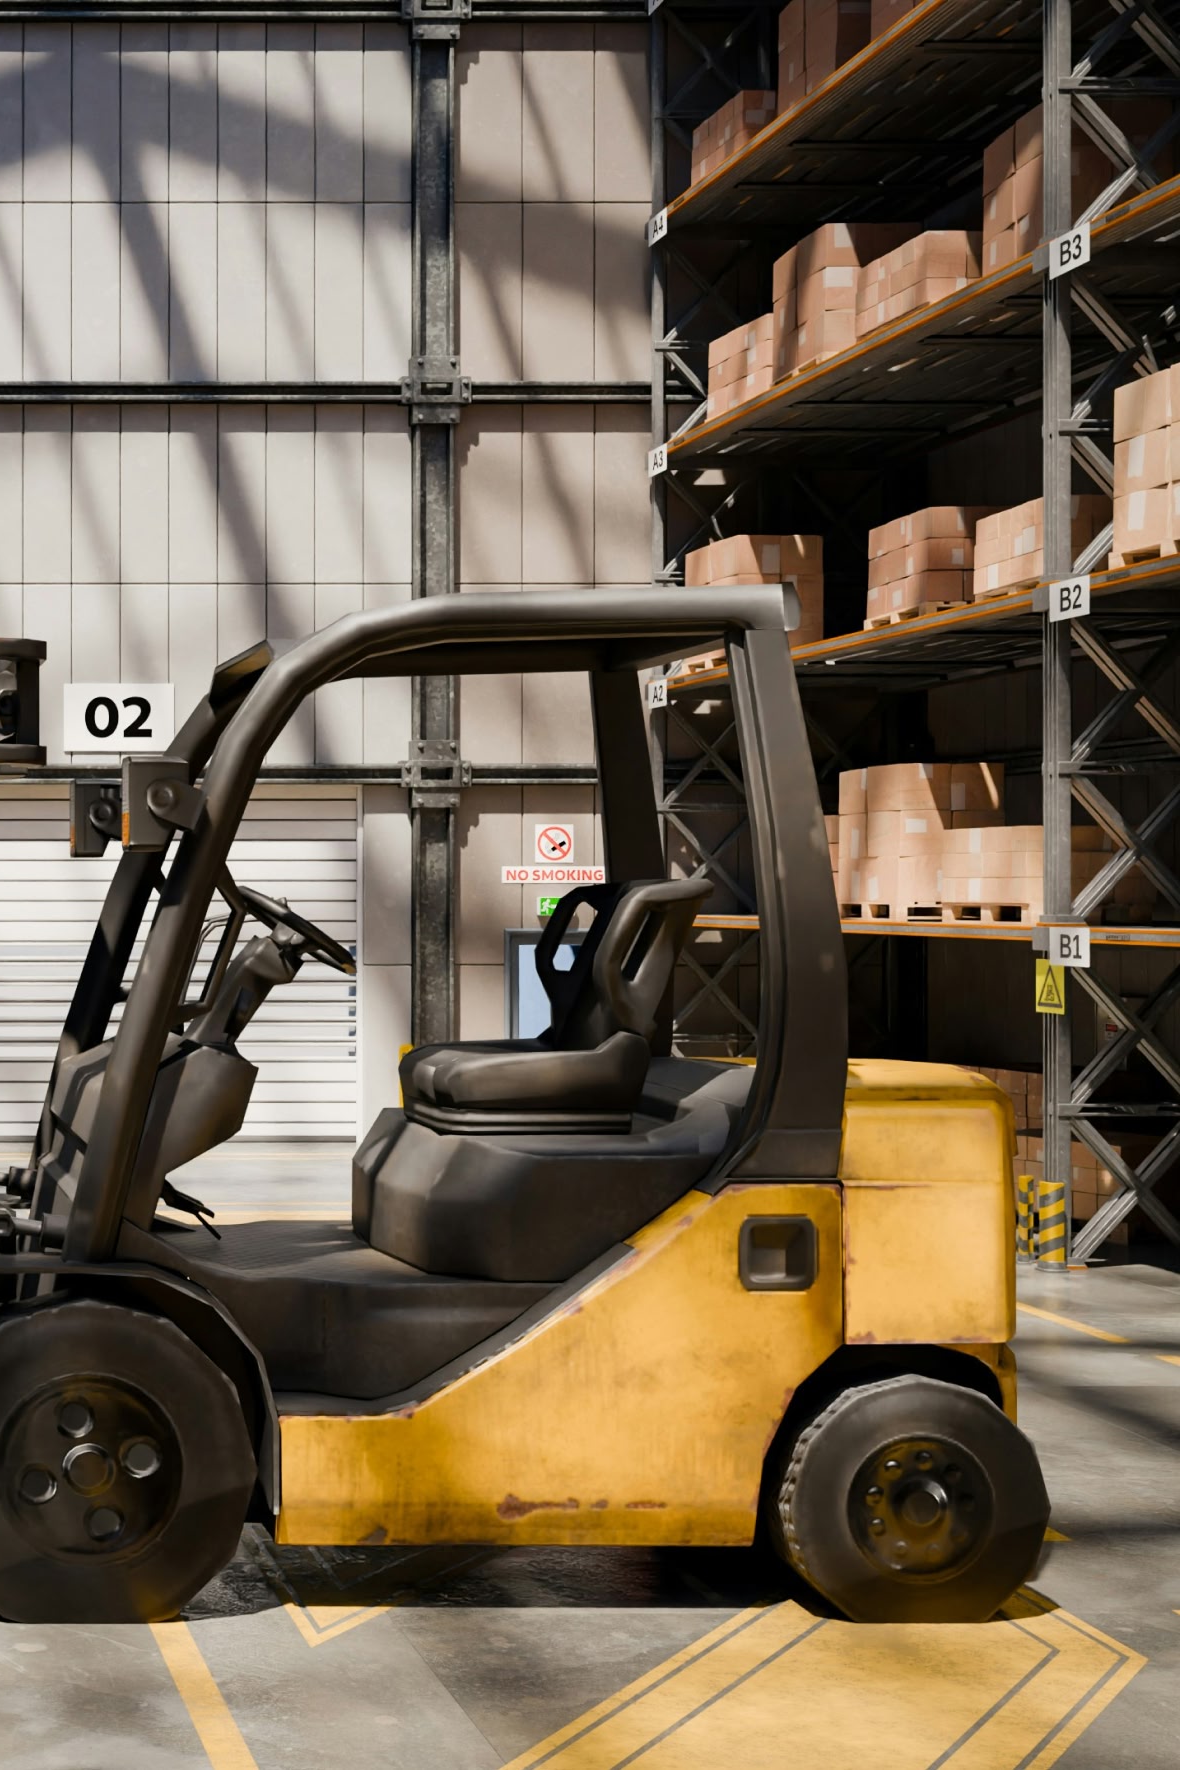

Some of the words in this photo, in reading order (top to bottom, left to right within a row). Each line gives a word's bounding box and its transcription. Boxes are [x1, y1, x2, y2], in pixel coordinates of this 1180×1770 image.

[652, 215, 664, 238] A4
[1059, 233, 1082, 267] B3
[652, 450, 664, 471] A3
[1059, 583, 1082, 612] B2
[652, 684, 664, 703] A2
[84, 696, 153, 738] 02
[506, 869, 529, 881] NO
[532, 869, 604, 881] SMOKING
[1059, 934, 1082, 959] B1
